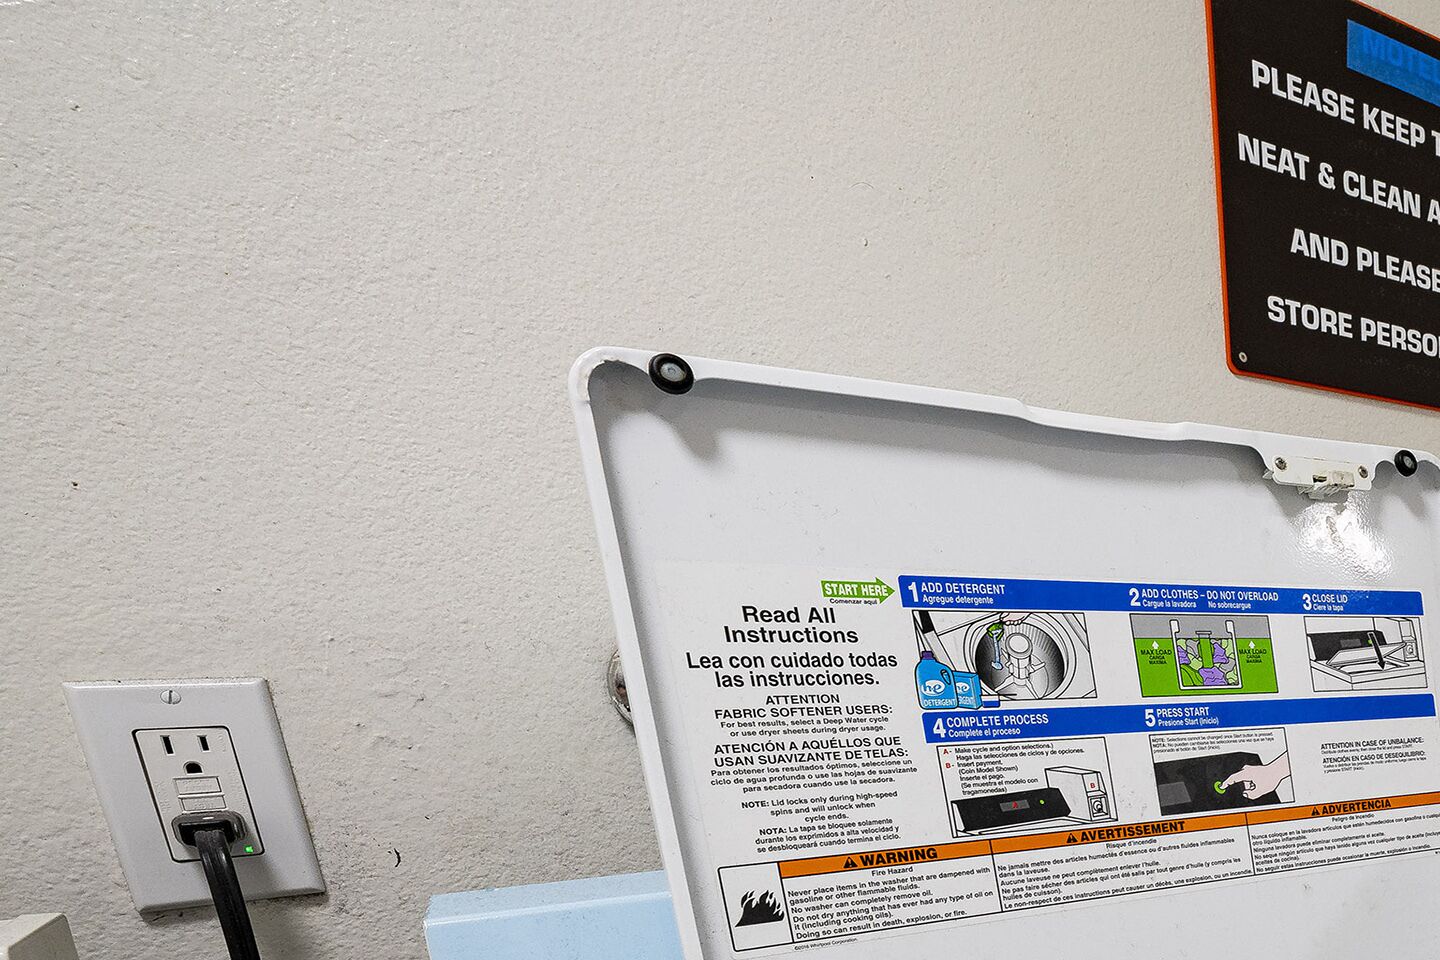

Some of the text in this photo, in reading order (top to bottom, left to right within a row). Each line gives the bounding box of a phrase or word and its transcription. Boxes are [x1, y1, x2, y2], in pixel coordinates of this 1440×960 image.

[1252, 59, 1355, 124] PLEASE
[1363, 103, 1426, 148] KEEP
[1238, 133, 1309, 180] NEAT
[1318, 163, 1335, 190] &
[1343, 170, 1421, 219] CLEAN
[1290, 228, 1348, 267] AND
[1267, 296, 1353, 339] STORE
[824, 584, 890, 596] START HERE
[908, 582, 1005, 602] 1 ADD DETERGENT
[1129, 588, 1140, 606] 2
[1141, 588, 1159, 600] ADD
[1160, 589, 1198, 601] CLOTHES
[1206, 590, 1218, 602] DO
[1219, 590, 1235, 602] NOT
[1237, 591, 1278, 601] OVERLOAD
[922, 595, 993, 605] Agregue detergente
[1142, 599, 1164, 608] Cargue
[1171, 600, 1196, 608] lavadora
[1217, 601, 1251, 610] sobrecargue
[1302, 593, 1348, 610] 3 CLOSE LID
[741, 606, 835, 623] Read All
[724, 626, 858, 643] Instructions
[686, 652, 897, 668] Lea con cuidado todas
[715, 670, 879, 687] las instrucciones.
[766, 694, 839, 705] ATTENTION
[924, 699, 956, 707] DETERGENT
[714, 704, 892, 719] FABRIC SOFTENER USERS:
[1145, 706, 1209, 726] 5 PRESS START
[811, 726, 837, 734] during
[933, 713, 1048, 738] 4 COMPLETE PROCESS
[1199, 717, 1219, 726] (Inicio)
[948, 728, 1020, 738] Complete el proceso
[714, 736, 901, 754] ATENCIÓN A AQUÉLLOS QUE
[714, 748, 908, 767] USAN SUAVIZANTE DE TELAS:
[956, 760, 1003, 769] Insert payment.
[1322, 799, 1391, 816] ADVERTENCIA
[1081, 821, 1185, 842] AVERTISSEMENT
[861, 848, 938, 866] WARNING
[887, 866, 913, 874] Hazard
[787, 889, 811, 897] Never
[938, 869, 974, 878] dampened
[789, 894, 823, 906] gasoline
[857, 886, 896, 896] flammable
